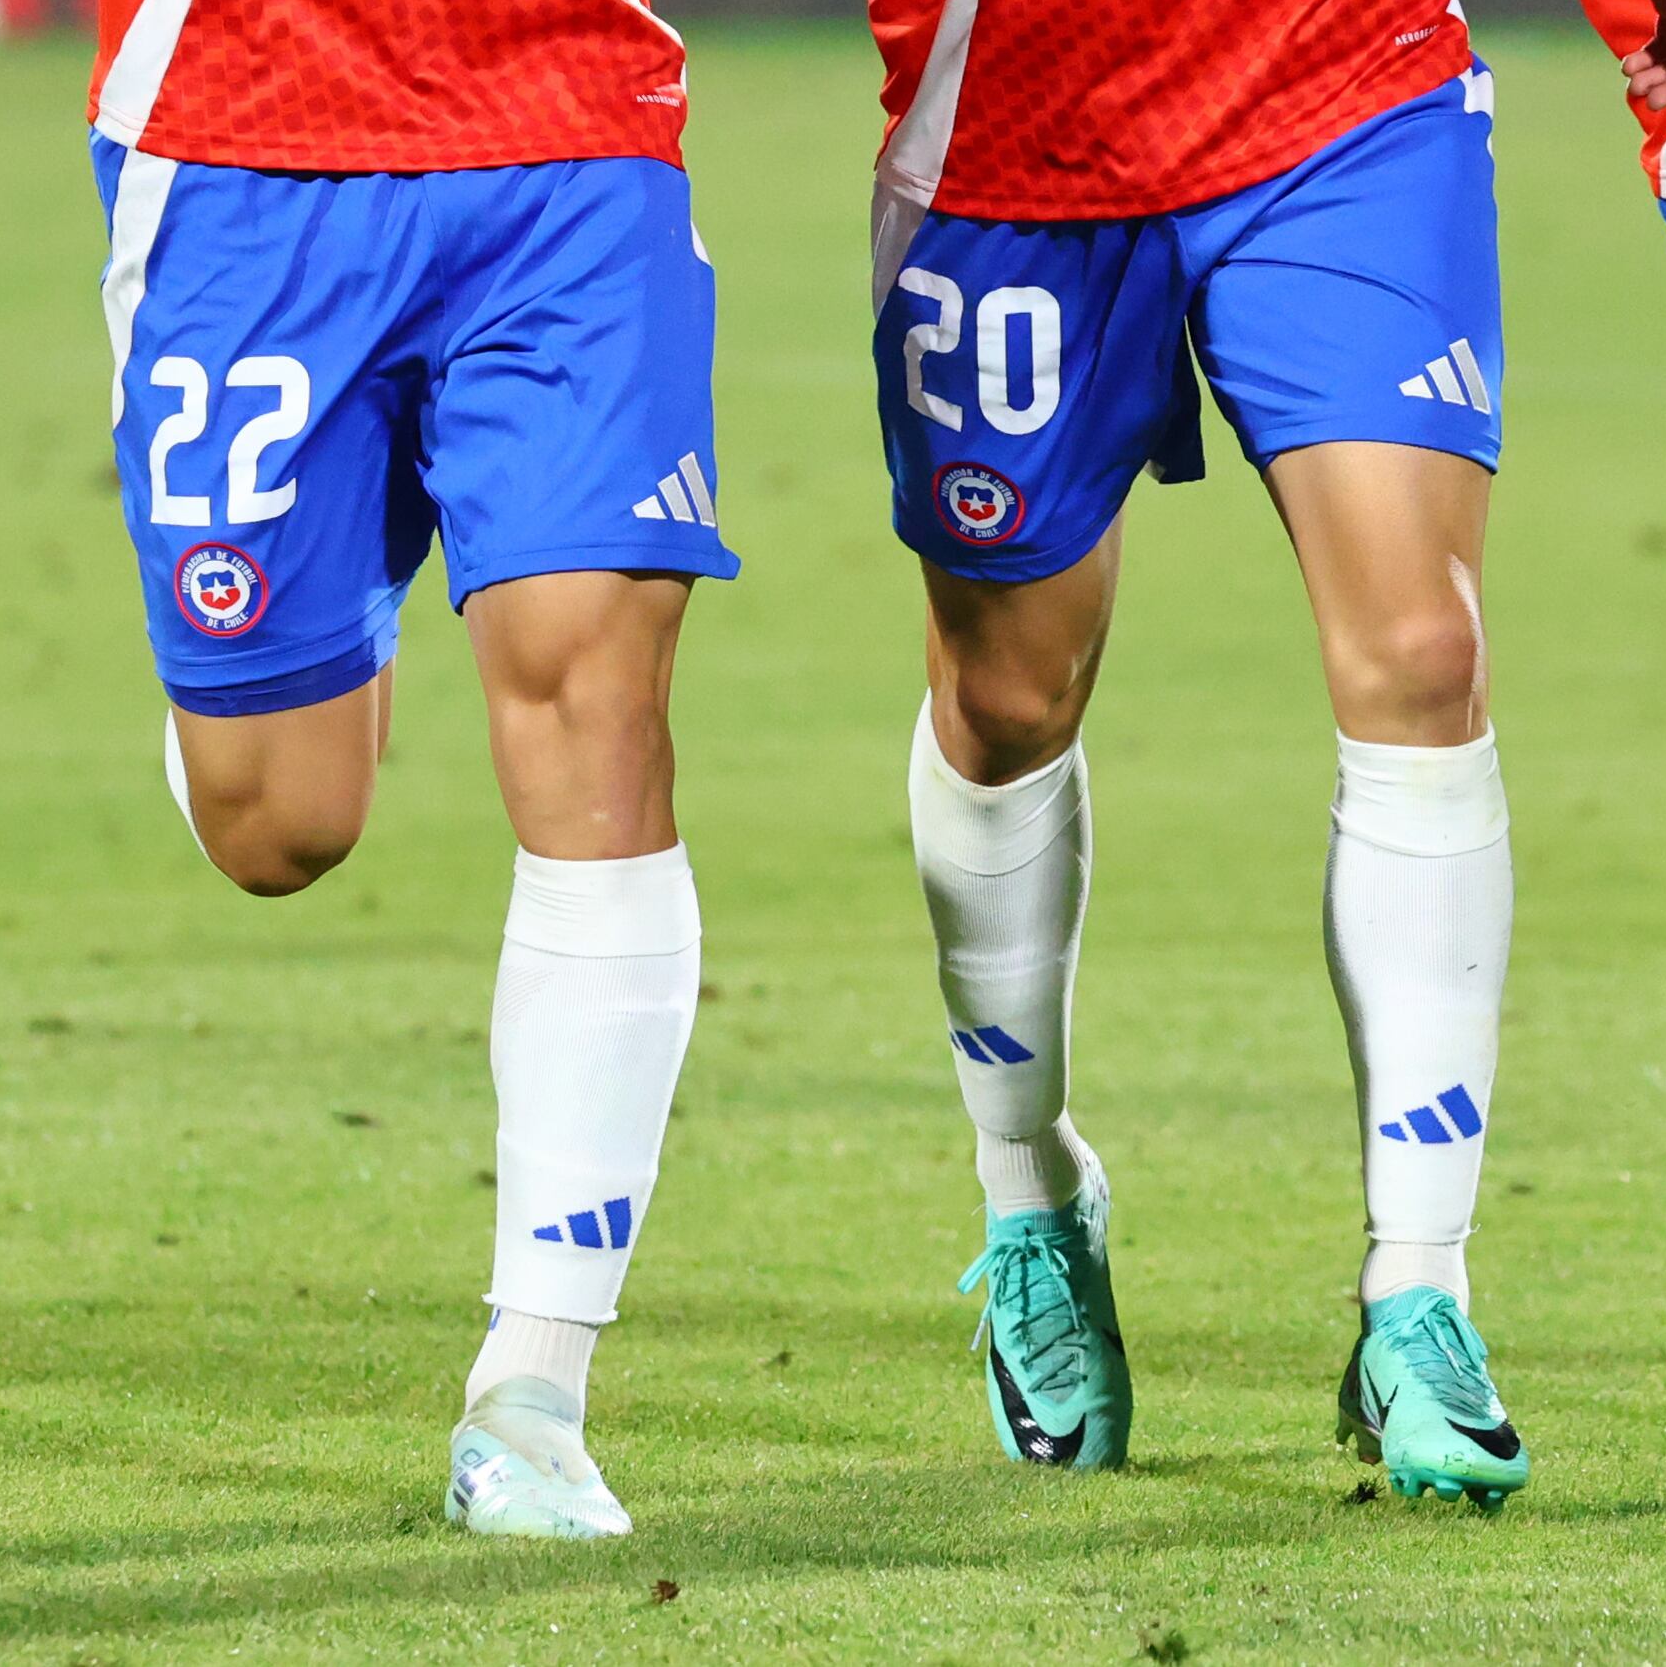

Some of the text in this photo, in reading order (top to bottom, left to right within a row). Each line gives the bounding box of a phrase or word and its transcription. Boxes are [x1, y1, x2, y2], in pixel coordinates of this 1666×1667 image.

[898, 266, 1061, 436] 20
[149, 355, 311, 527] 22
[979, 471, 991, 481] DE
[959, 523, 971, 535] DE
[216, 550, 228, 561] DE
[231, 556, 259, 585] FUTBOL
[206, 612, 249, 629] DE CHILE
